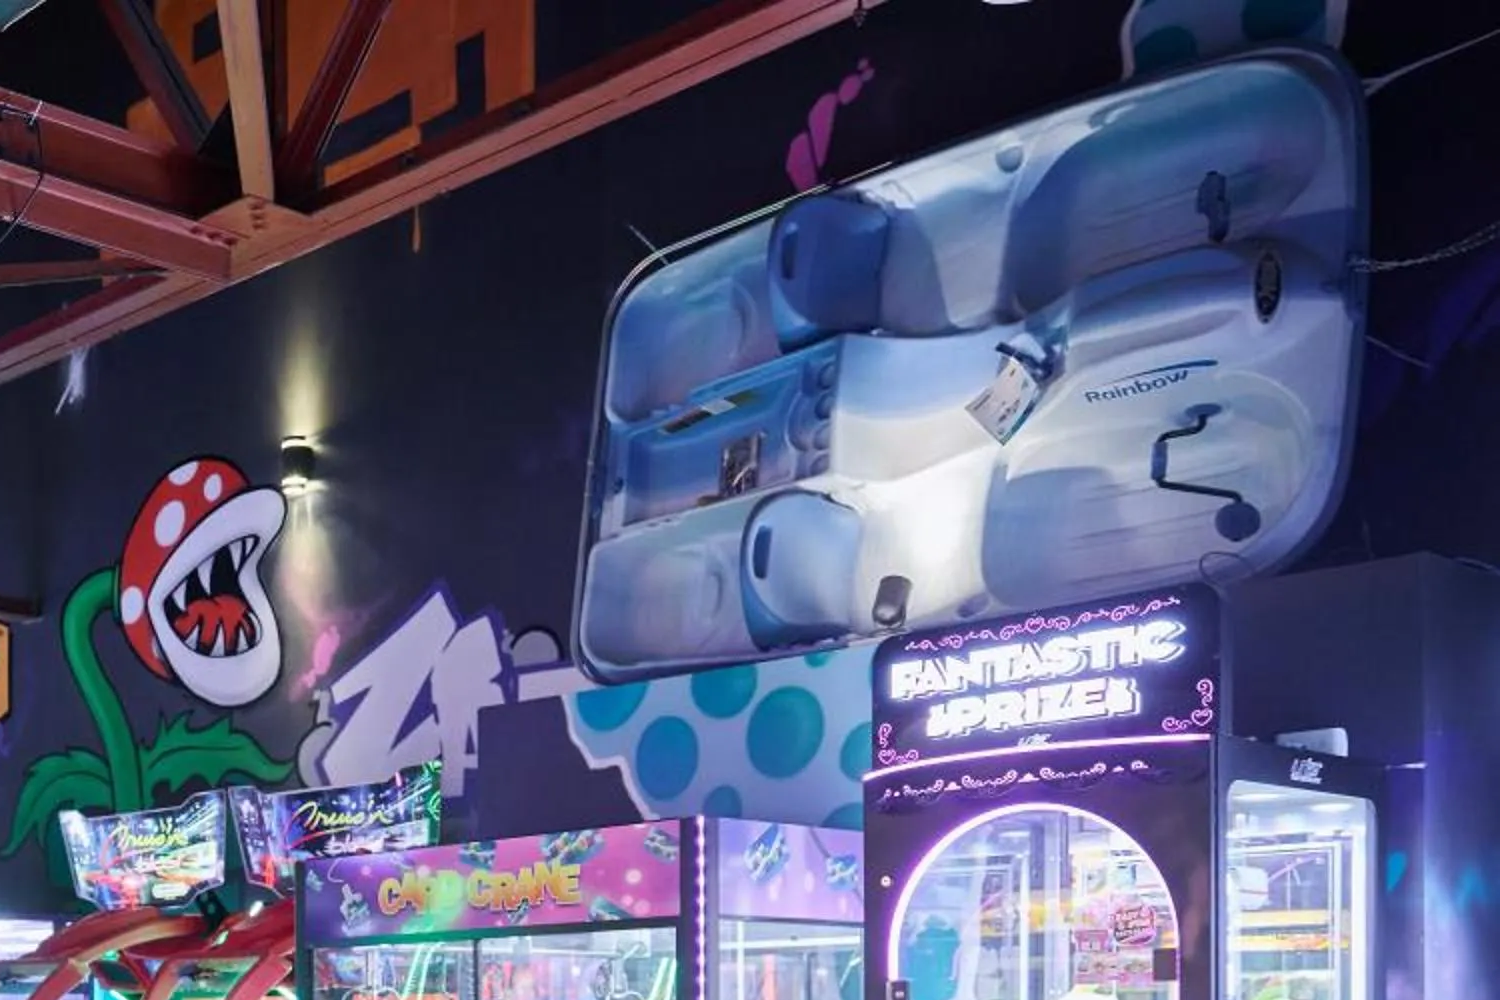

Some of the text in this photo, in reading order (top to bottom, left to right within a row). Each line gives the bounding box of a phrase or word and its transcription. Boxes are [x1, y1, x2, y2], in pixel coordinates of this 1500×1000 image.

[1084, 369, 1189, 403] Rainbow
[891, 620, 1186, 700] FANTASTIC
[378, 860, 581, 915] CARD CRANE
